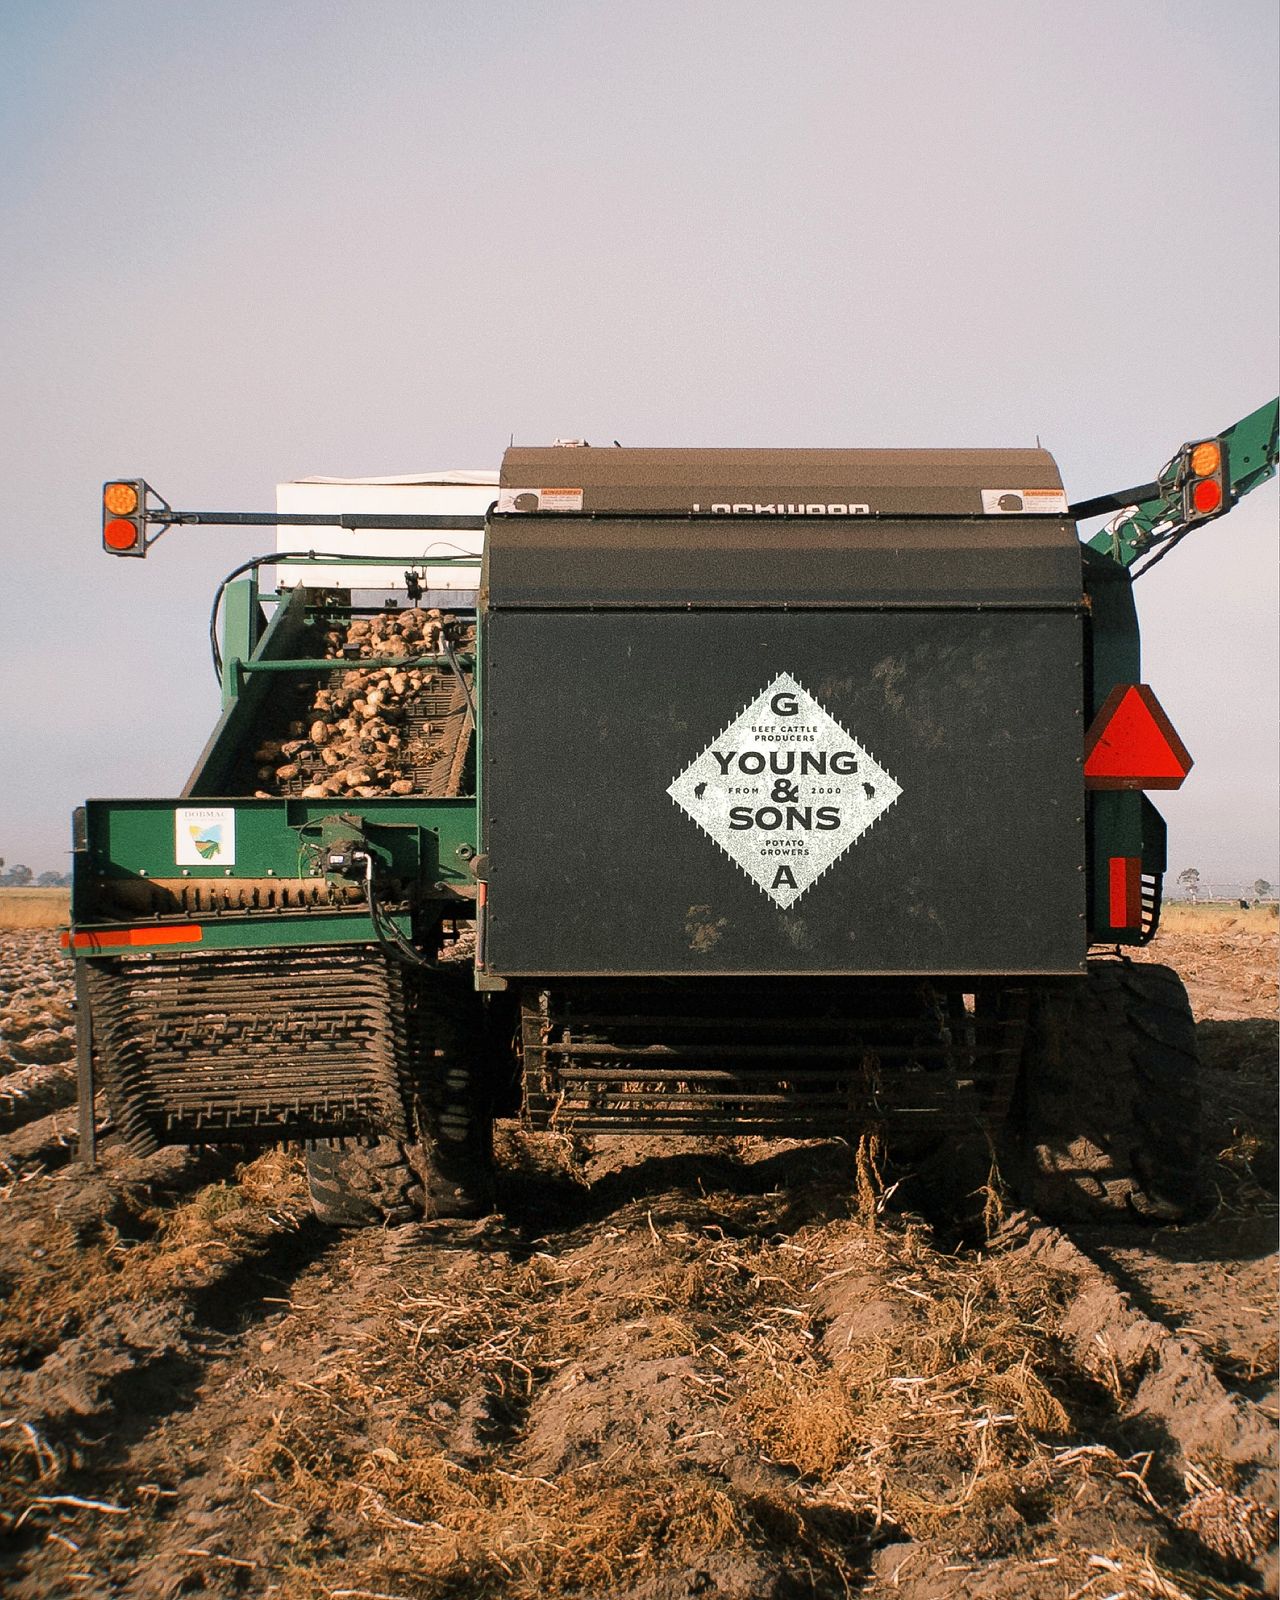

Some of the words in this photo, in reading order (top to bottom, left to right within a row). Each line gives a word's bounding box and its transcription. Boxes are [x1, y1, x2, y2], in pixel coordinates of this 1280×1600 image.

[771, 692, 799, 717] G
[711, 751, 858, 775] YOUNG
[770, 778, 799, 803] &
[728, 806, 841, 831] SONS
[770, 865, 799, 889] A
